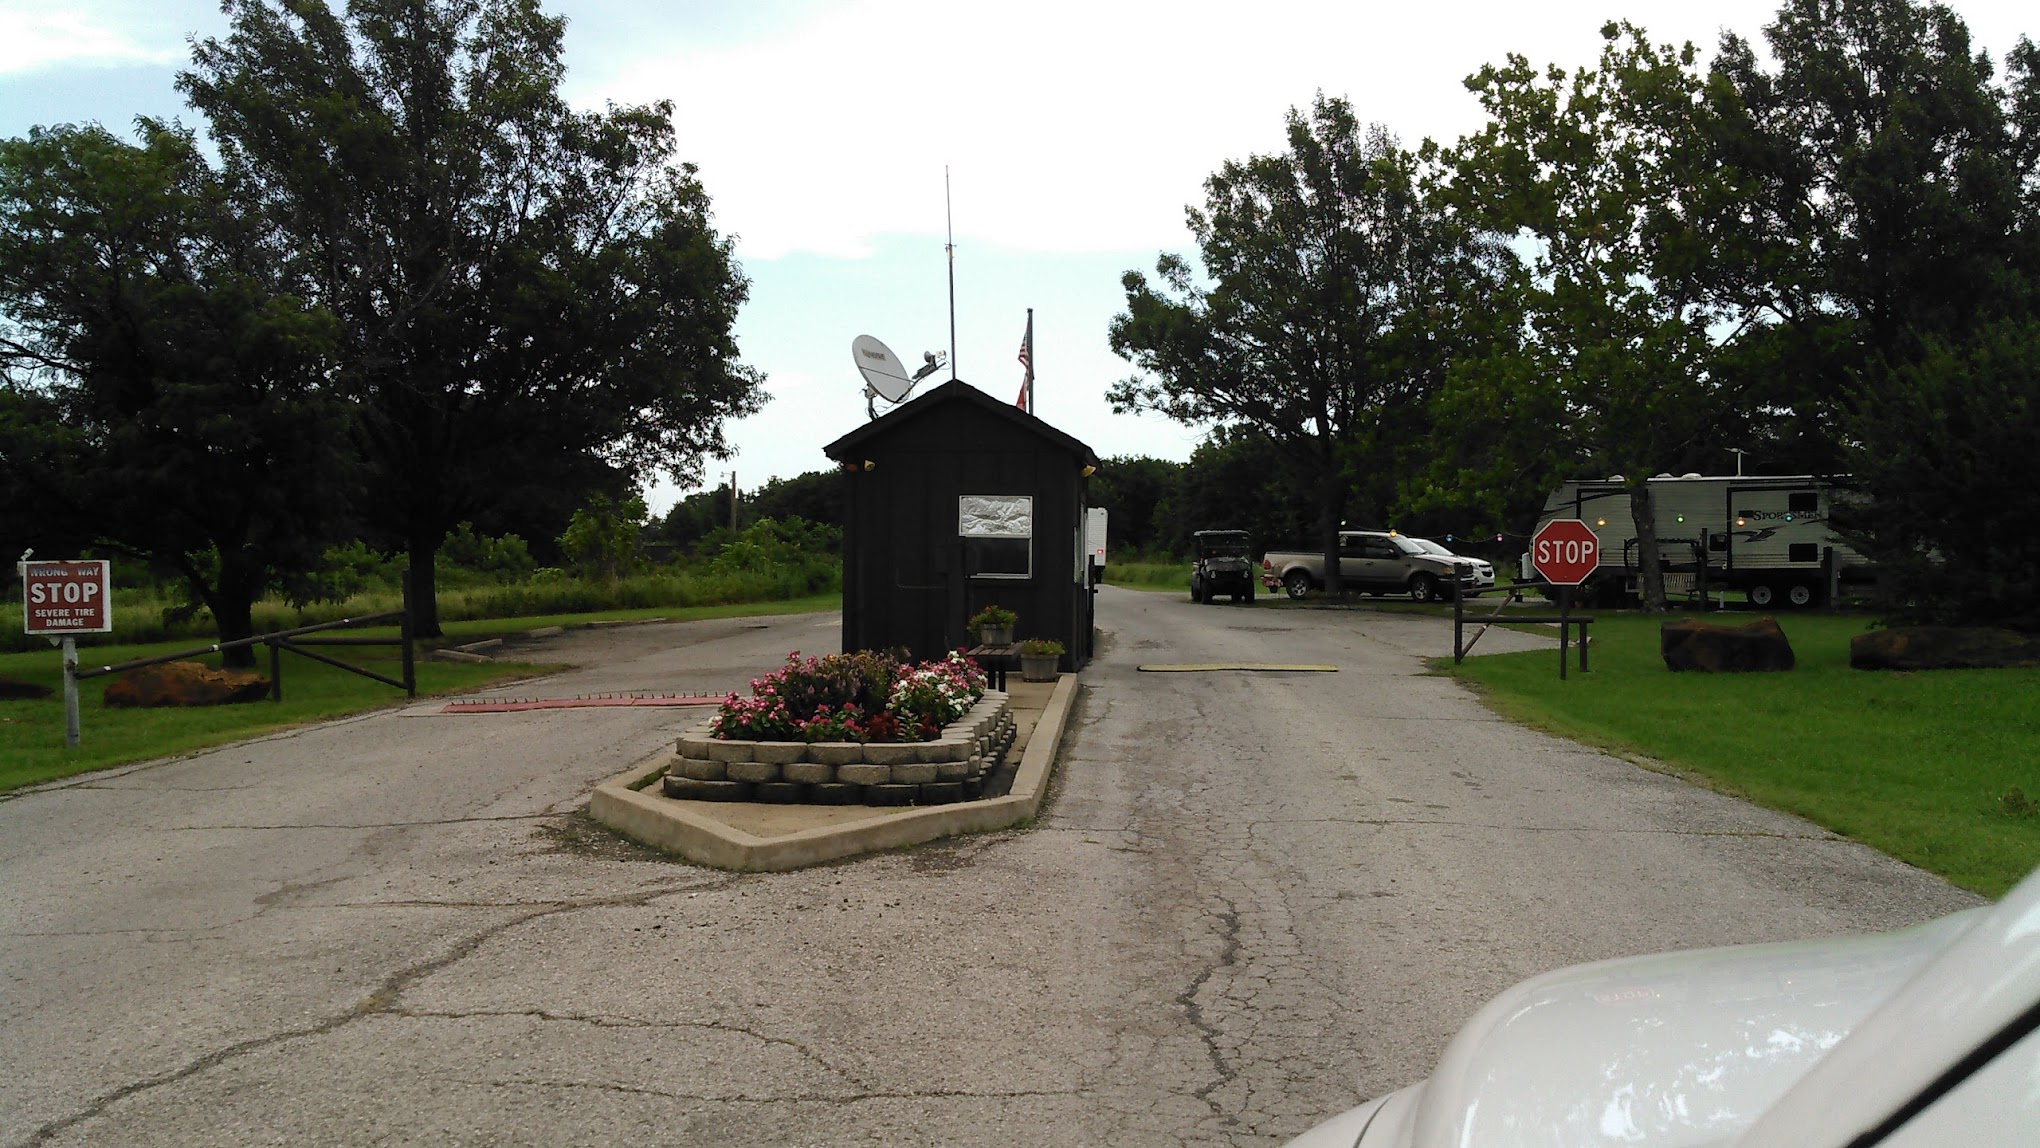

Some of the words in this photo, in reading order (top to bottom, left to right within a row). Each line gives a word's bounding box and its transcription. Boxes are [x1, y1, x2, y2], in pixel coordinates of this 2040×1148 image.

[1753, 510, 1822, 521] SPORSMEN
[1538, 540, 1594, 564] STOP
[30, 567, 68, 577] WRONG
[77, 567, 99, 576] WAY
[30, 582, 99, 603] STOP
[35, 608, 70, 617] SEVERE
[74, 608, 95, 616] TIRE
[46, 618, 84, 627] DAMAGE
